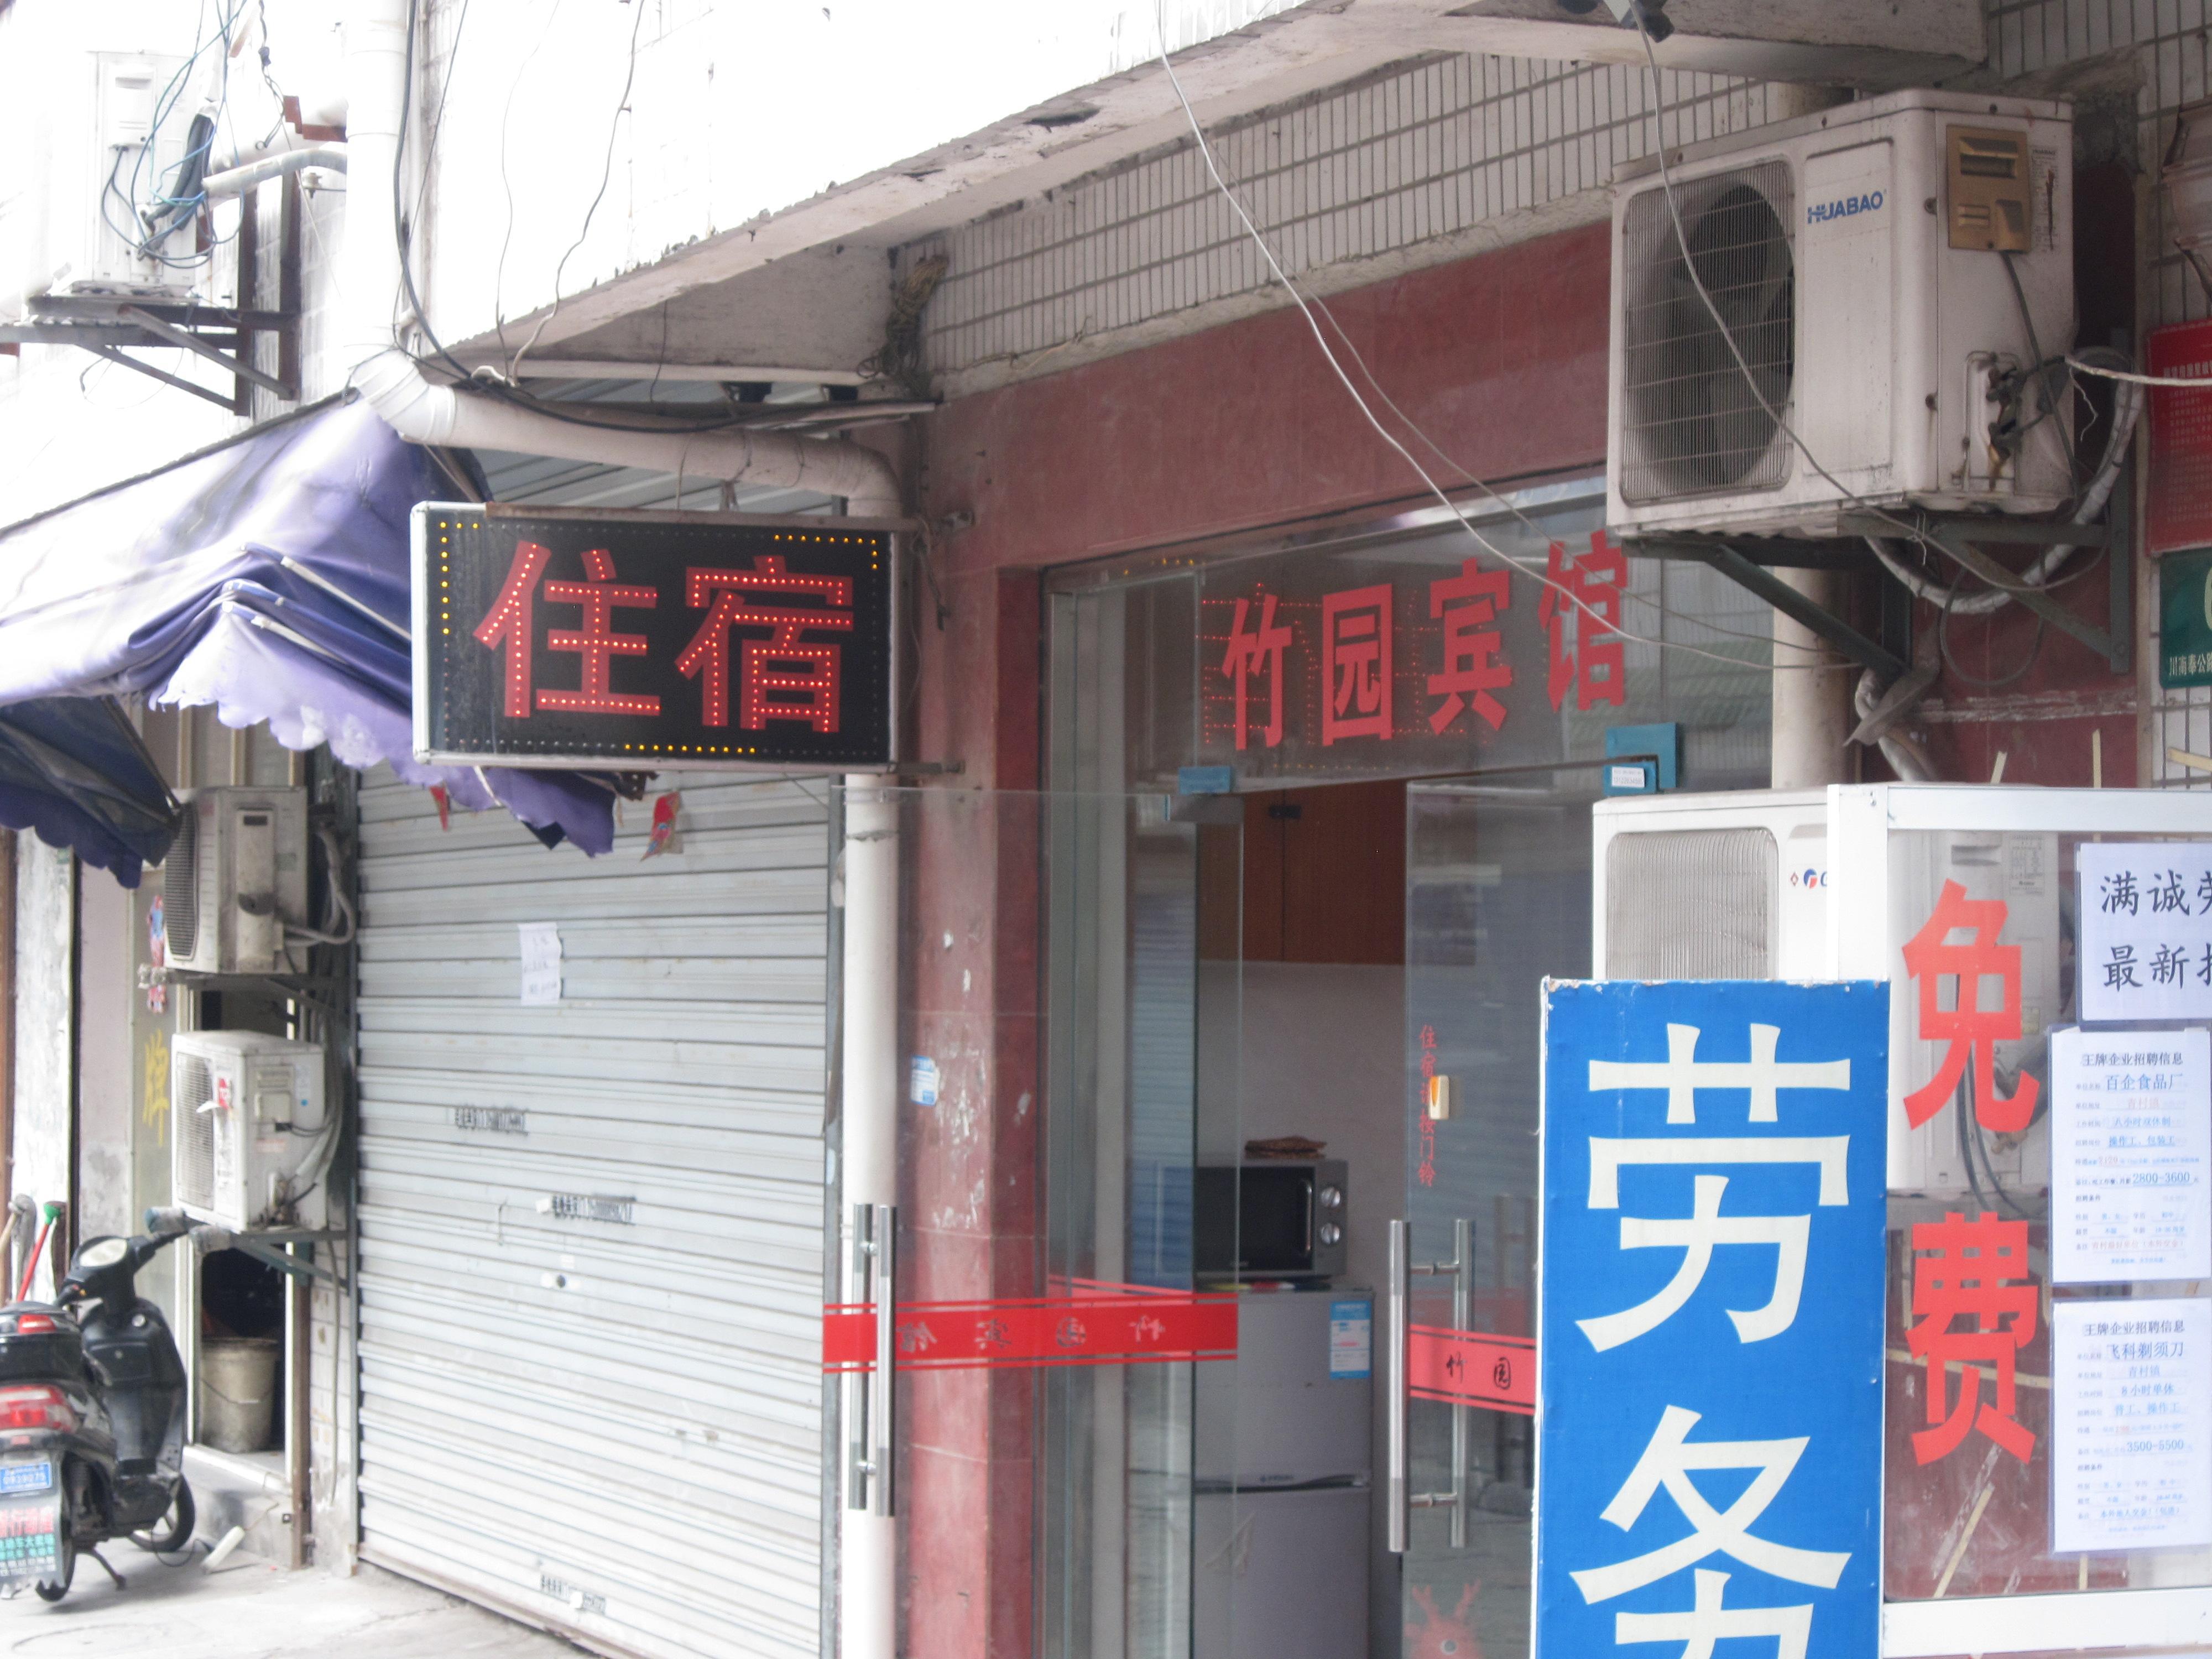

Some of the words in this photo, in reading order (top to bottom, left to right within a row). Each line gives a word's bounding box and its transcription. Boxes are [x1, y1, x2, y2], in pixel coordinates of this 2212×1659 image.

[1808, 191, 1884, 223] HUABAO
[473, 540, 853, 733] 住宿
[1221, 529, 1627, 750] 竹园宾馆
[2082, 1052, 2183, 1067] 王牌企业招聘信息
[2106, 1073, 2183, 1091] 百企食品厂
[1902, 878, 2041, 1466] 免费
[2133, 1172, 2190, 1184] 2800-3600
[2084, 1319, 2185, 1336] 王牌企业招聘信息
[1569, 1022, 1853, 1659] 劳务
[2107, 1342, 2184, 1360] 飞科剃须刀
[2127, 1439, 2184, 1453] 3500-5500
